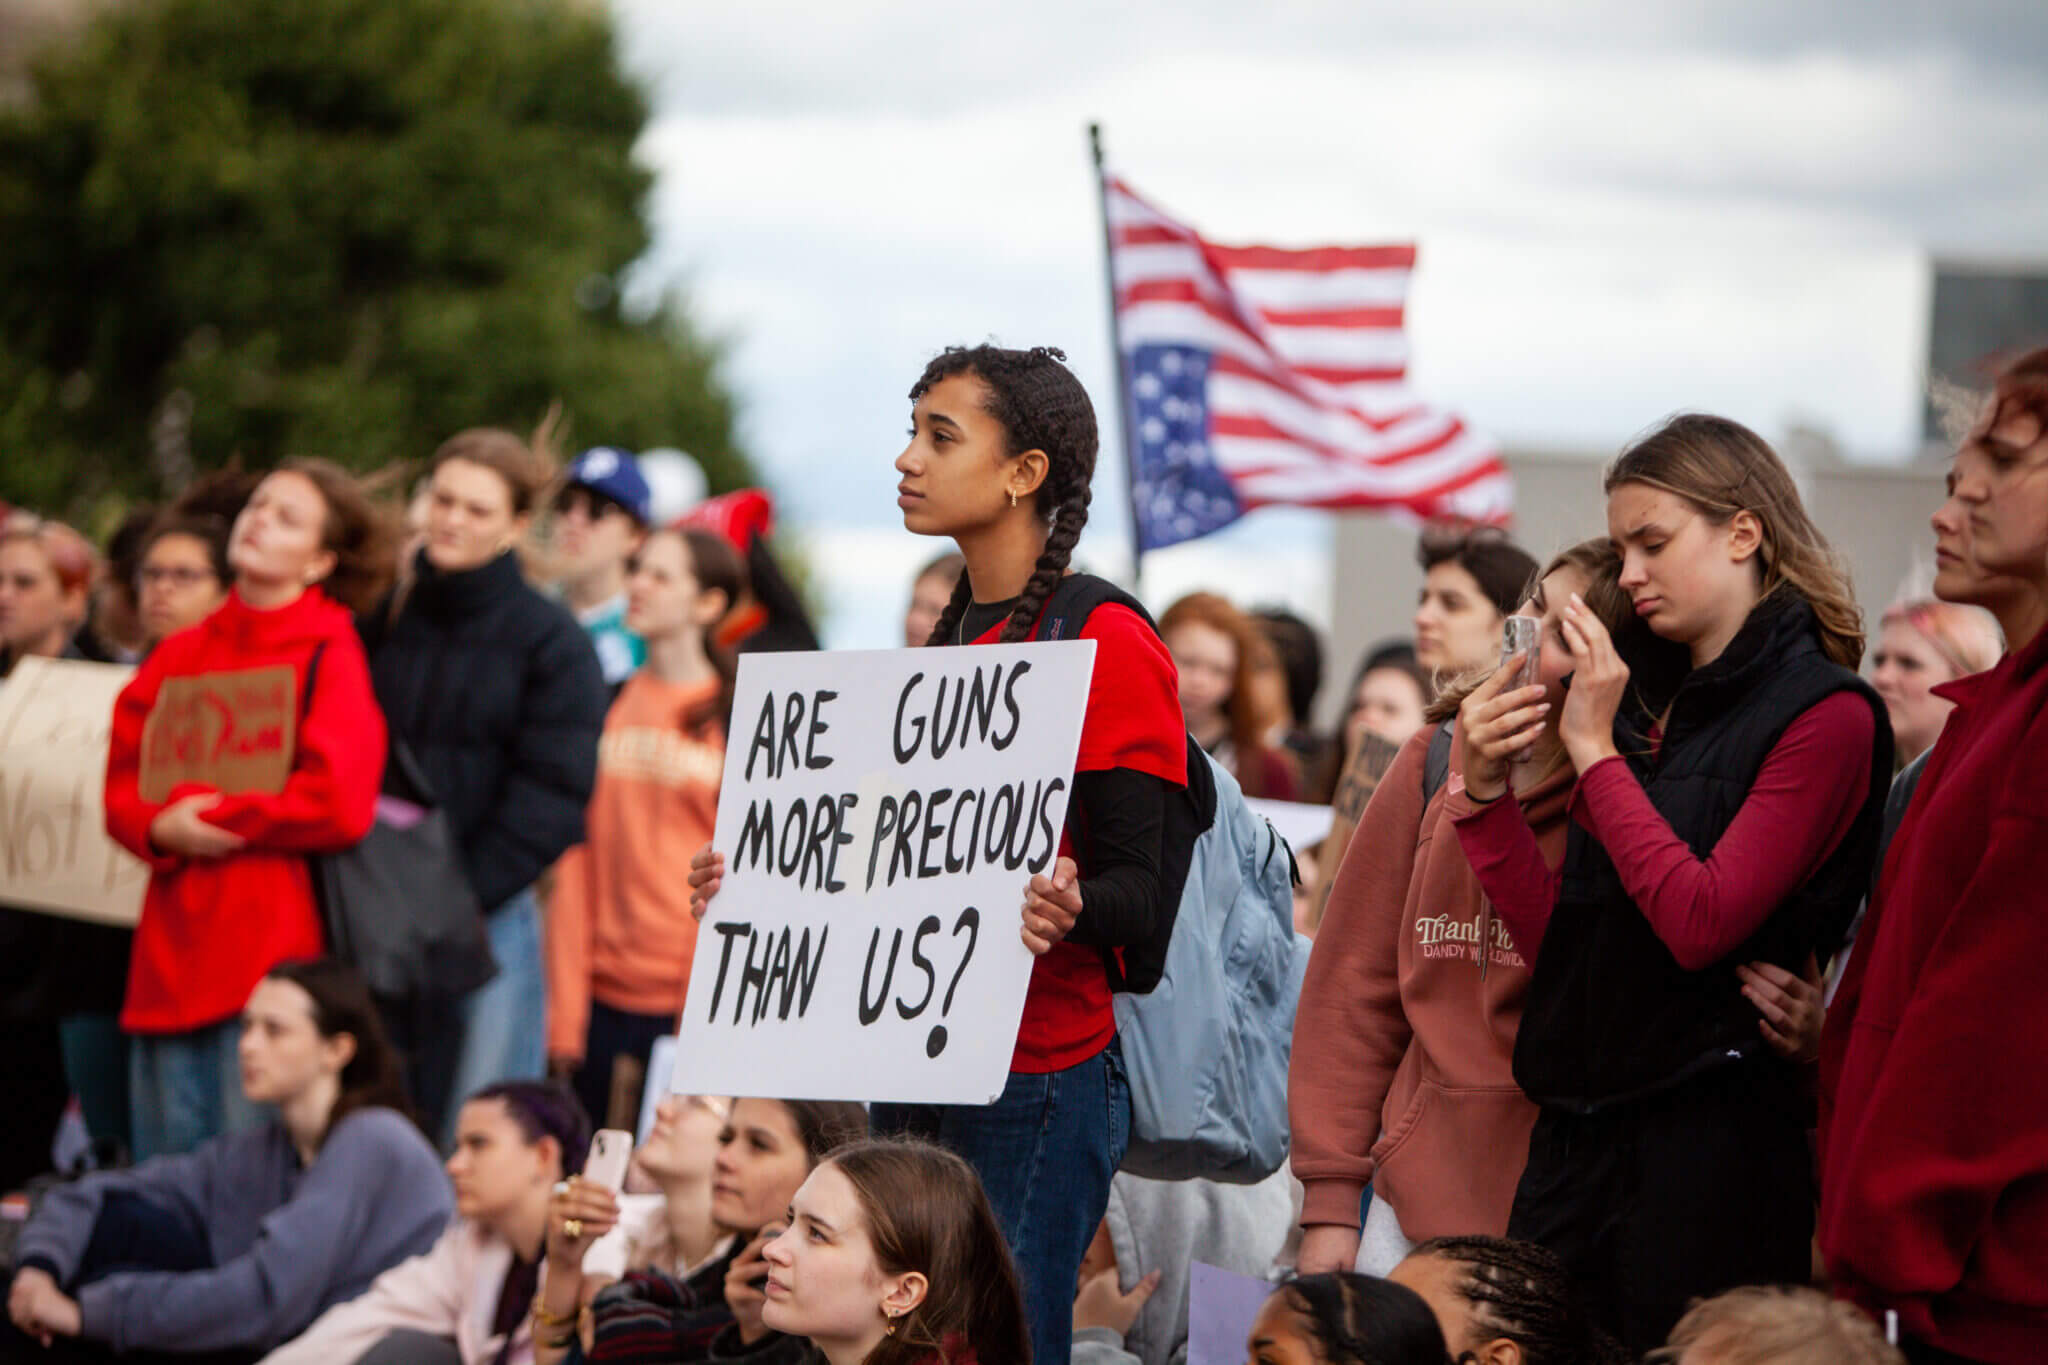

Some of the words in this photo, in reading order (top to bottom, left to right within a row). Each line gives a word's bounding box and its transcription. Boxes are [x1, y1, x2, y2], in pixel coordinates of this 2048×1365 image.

[746, 691, 838, 782] ARE
[893, 660, 1032, 765] GUNS
[733, 793, 858, 894] MORE
[865, 777, 1065, 893] PRECIOUS
[708, 922, 829, 1027] THAN
[858, 906, 980, 1059] US?
[1423, 944, 1465, 960] DANDY
